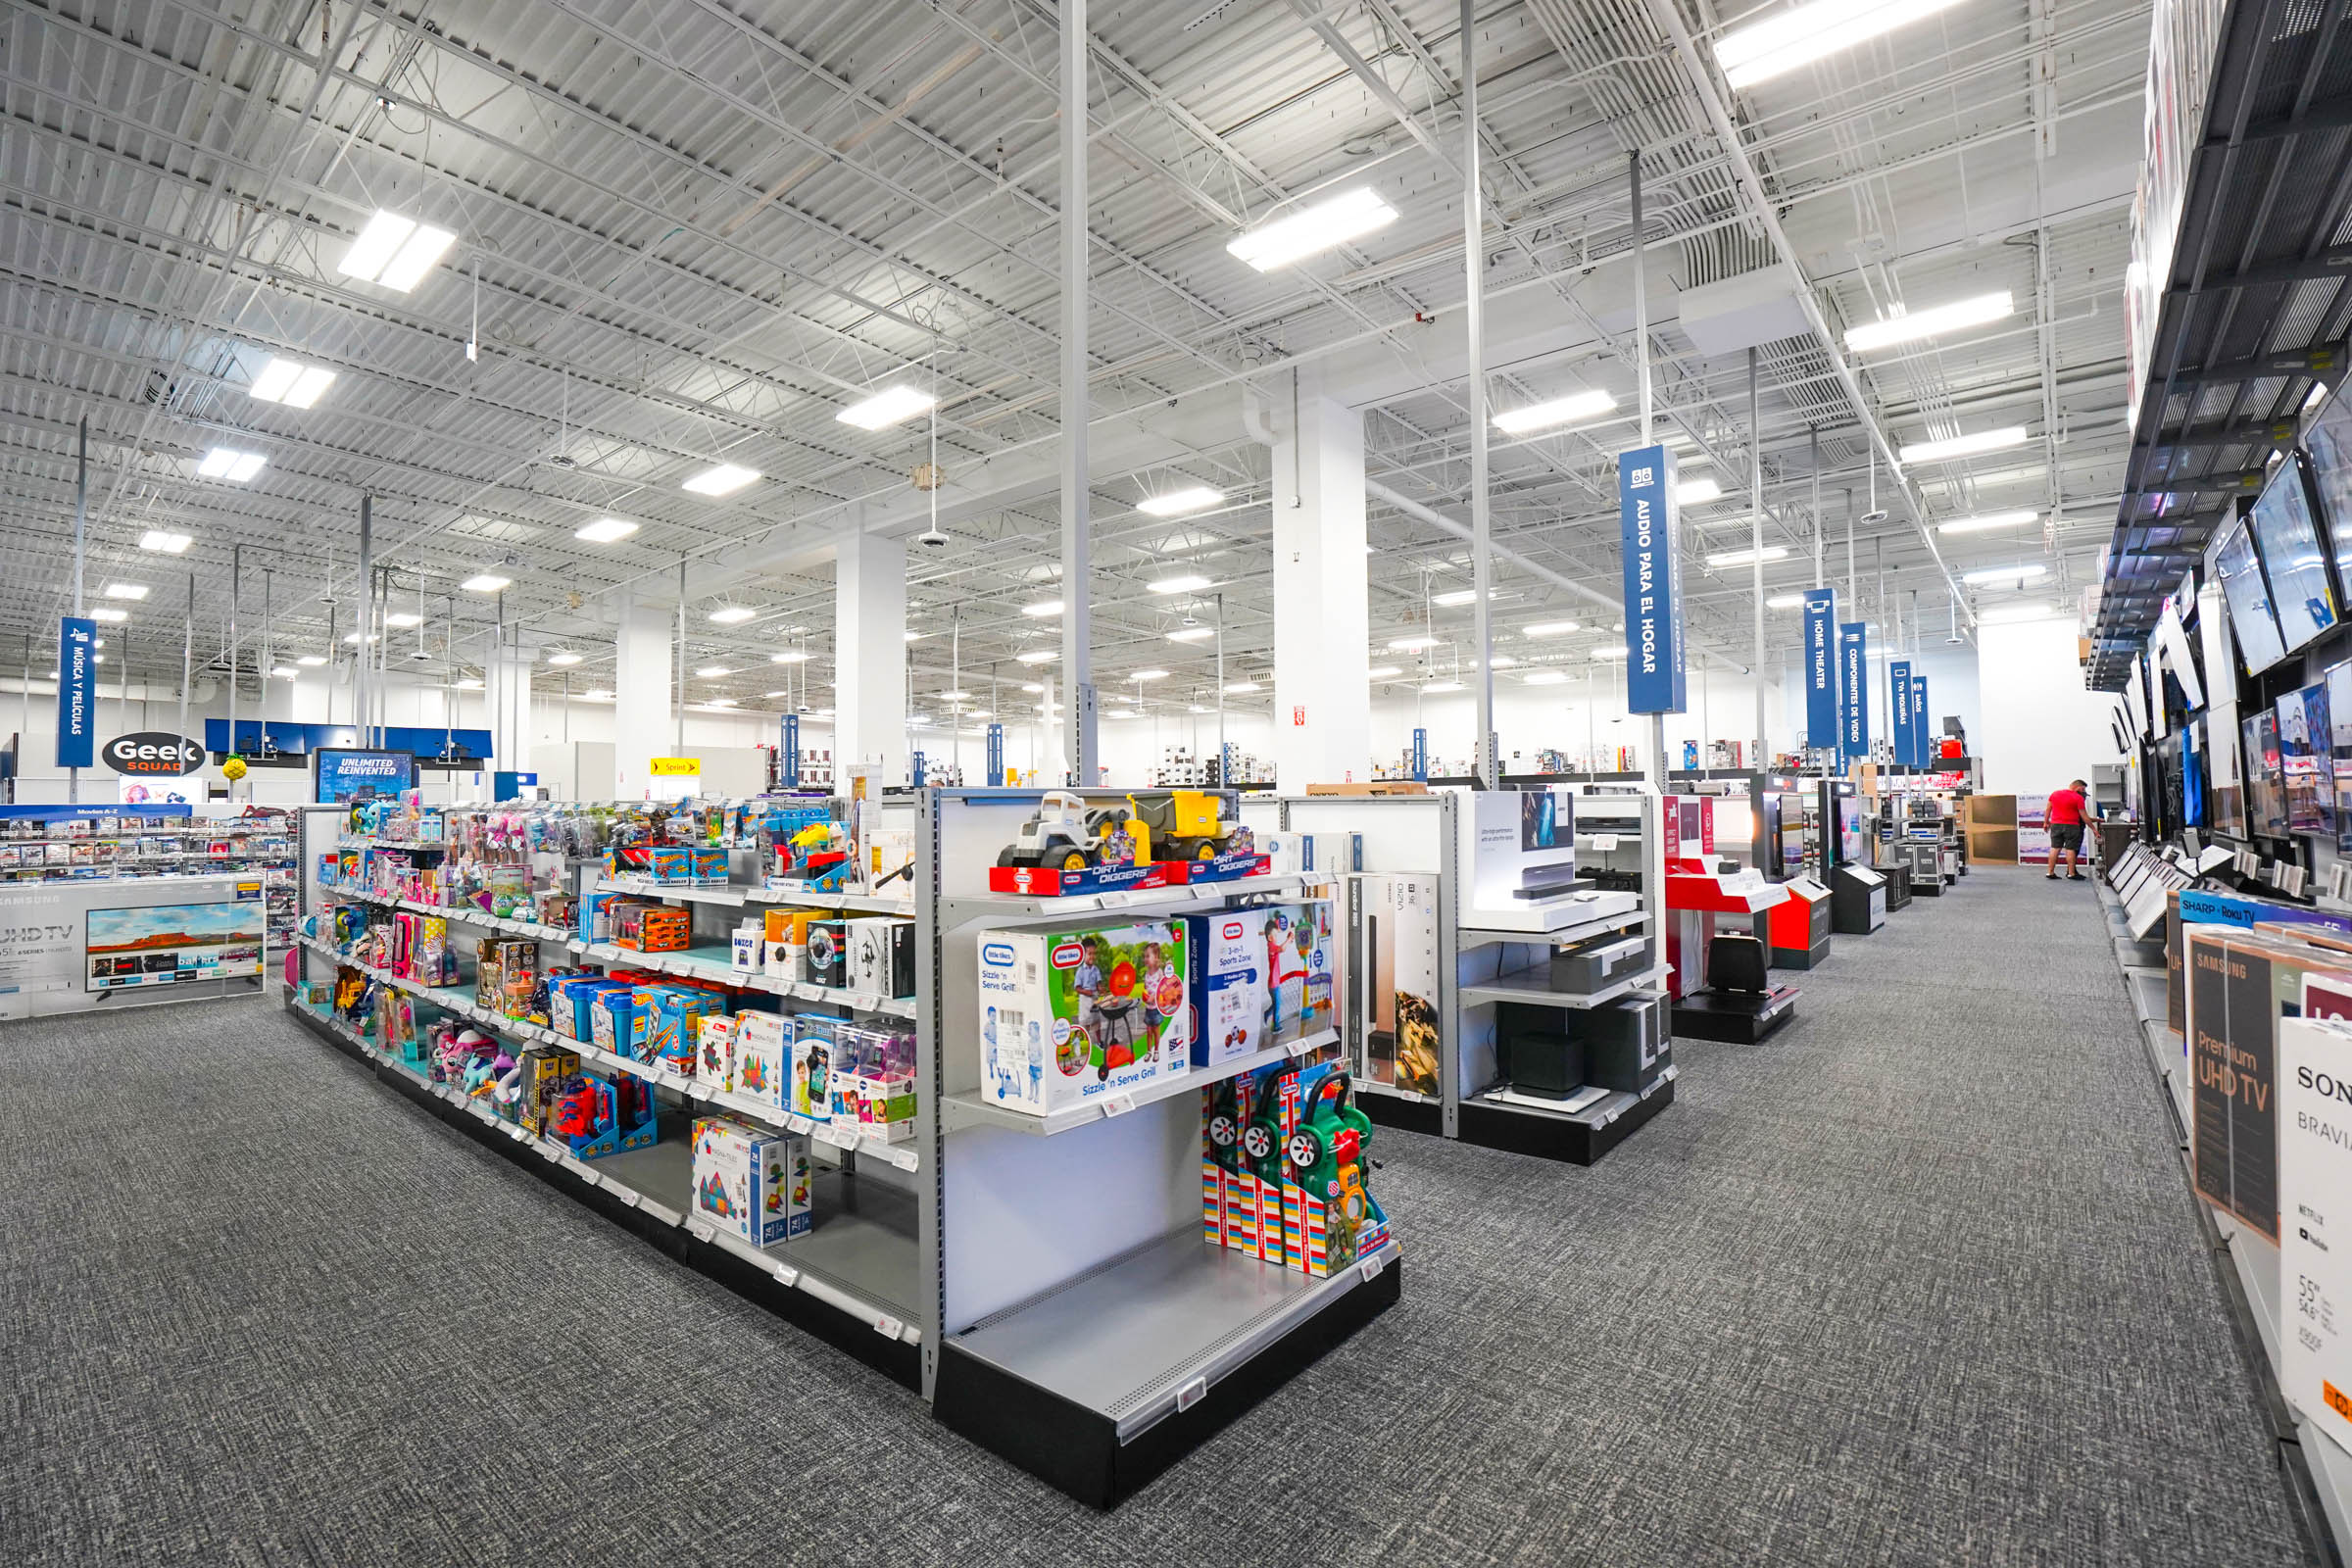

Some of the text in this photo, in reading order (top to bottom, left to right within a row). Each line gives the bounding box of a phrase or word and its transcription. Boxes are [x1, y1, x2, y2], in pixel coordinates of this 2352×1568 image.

[1637, 499, 1655, 674] AUDIO PARA EL HOGAR
[1814, 619, 1826, 690] HOME THEATER
[73, 646, 84, 680] MÚSICA
[1849, 648, 1858, 706] COMPONENTES
[71, 690, 85, 735] PELÍCULAS
[1851, 707, 1859, 717] DE
[1898, 694, 1907, 725] PEQUEÑAS
[114, 740, 197, 761] Geek
[127, 761, 182, 771] SQUAD
[337, 765, 397, 775] REINVENTED
[341, 758, 394, 767] UNLIMITED
[666, 763, 686, 773] Sprint
[1213, 855, 1234, 865] DIRT
[1218, 858, 1255, 872] DIGGERS
[1092, 864, 1119, 875] DIRT
[1099, 868, 1148, 884] DIGGERS
[2182, 900, 2254, 921] SHARP Roku TV
[45, 924, 74, 941] TV
[734, 938, 754, 949] BOXER
[1219, 955, 1251, 966] Sports Zone
[2197, 953, 2247, 979] SAMSUNG
[982, 970, 1000, 980] Sizzle
[982, 981, 1000, 990] Serve
[2198, 1030, 2258, 1071] Premium
[1082, 1083, 1106, 1097] Sizzle
[1116, 1074, 1139, 1087] Serve
[1141, 1066, 1156, 1080] Grill
[2199, 1055, 2268, 1112] UHD TV
[2298, 1203, 2324, 1226] NETFLIX
[765, 1226, 772, 1239] 74
[792, 1219, 798, 1230] 74
